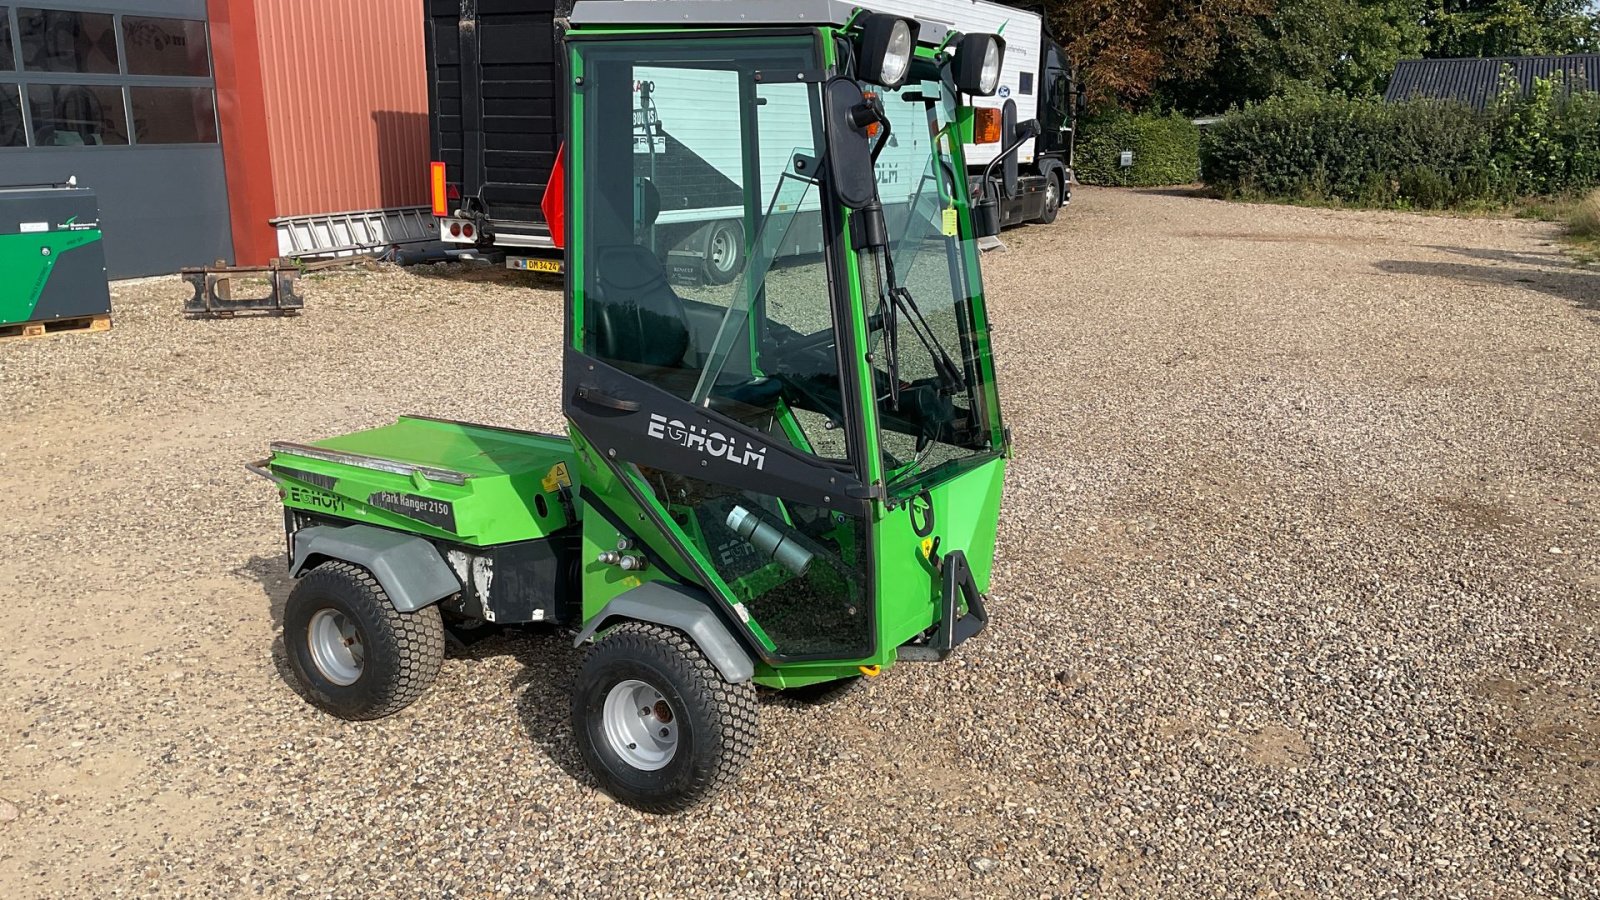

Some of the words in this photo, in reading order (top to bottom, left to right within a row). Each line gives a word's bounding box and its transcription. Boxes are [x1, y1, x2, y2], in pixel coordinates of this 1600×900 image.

[647, 412, 767, 471] EGHOLM
[381, 491, 399, 505] Park
[428, 501, 449, 516] 2150
[718, 536, 756, 565] EGH
